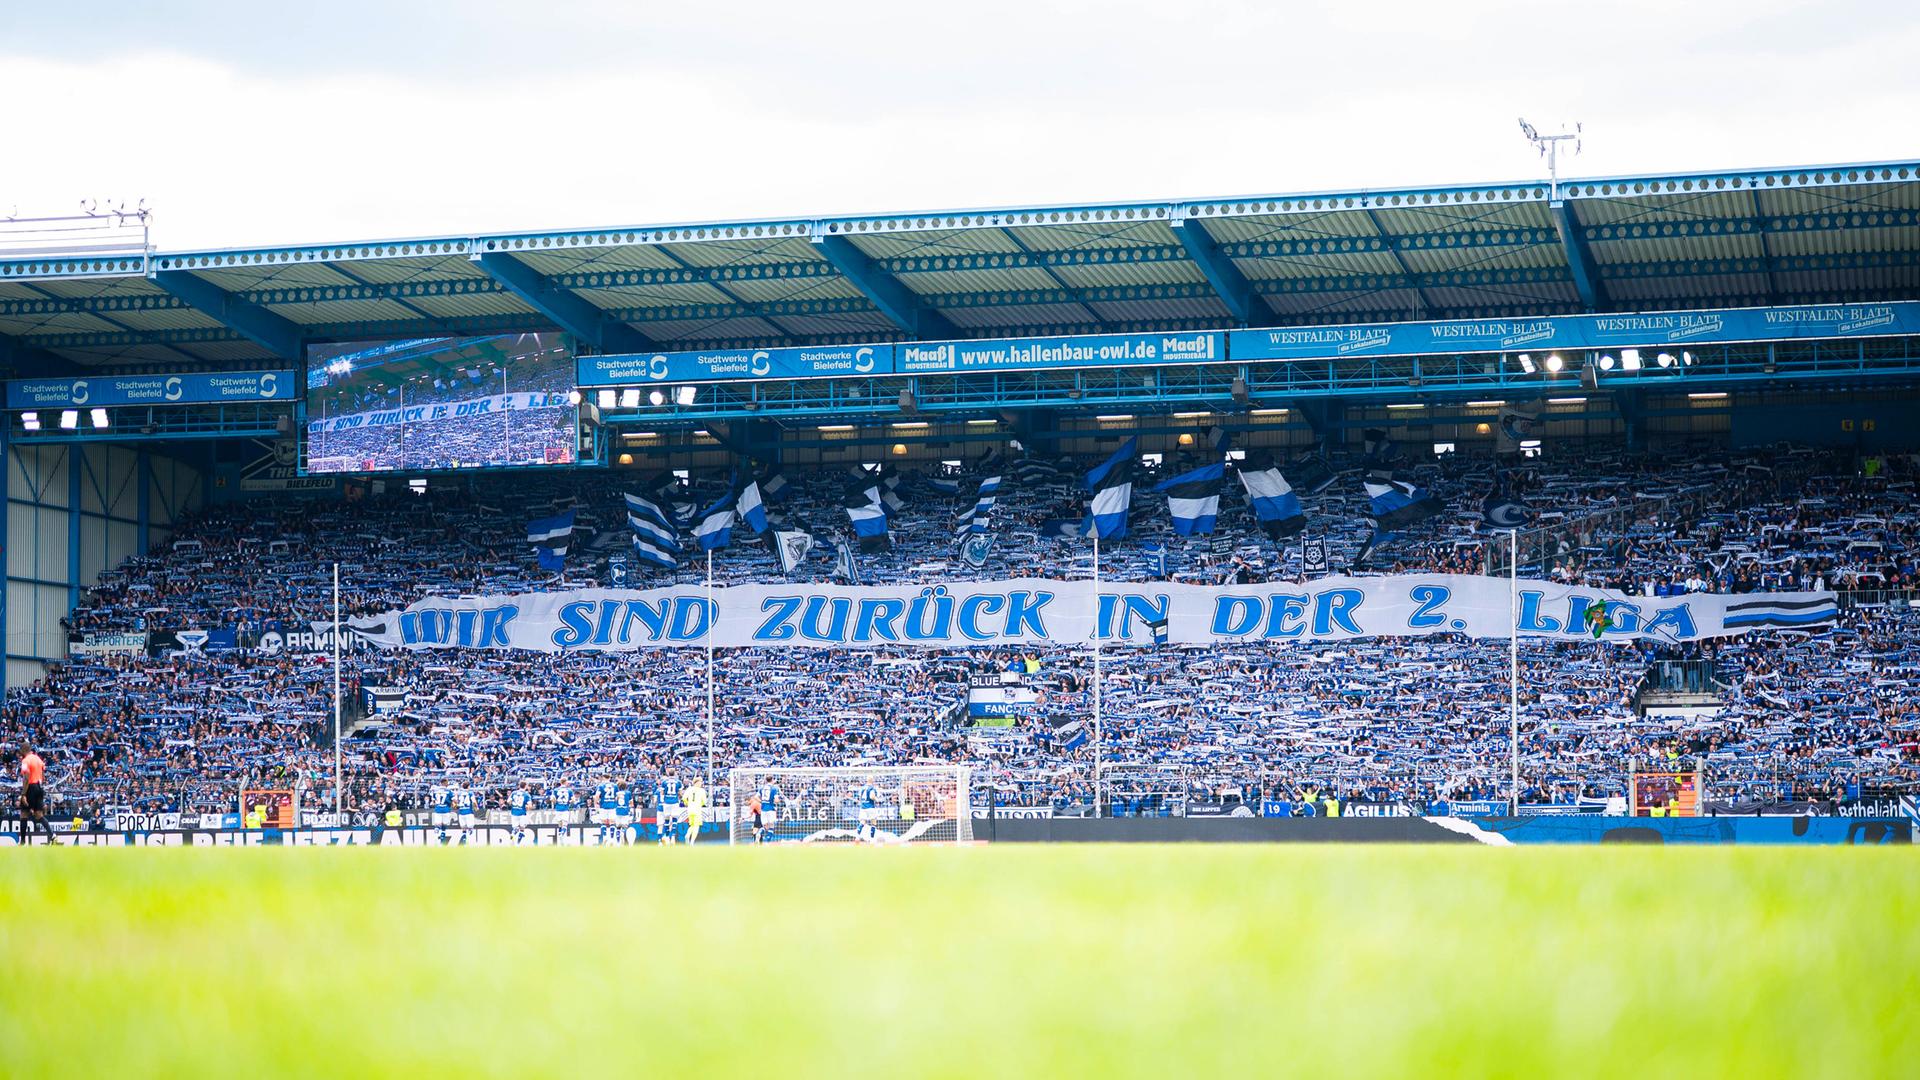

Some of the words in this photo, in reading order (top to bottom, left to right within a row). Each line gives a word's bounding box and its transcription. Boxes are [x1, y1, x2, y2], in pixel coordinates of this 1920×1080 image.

[1765, 307, 1892, 323] WESTFALEN-BLATT
[1596, 315, 1720, 331] WESTFALEN-BLATT
[1431, 322, 1552, 337] WESTFALEN-BLATT
[1269, 329, 1389, 344] WESTFALEN-BLATT
[1162, 336, 1206, 352] Maaß
[800, 351, 852, 362] Stadtwerke
[905, 346, 947, 362] Maaß
[961, 341, 1156, 365] www.hallenbau-owl.de
[596, 359, 646, 370] Stadtwerke
[697, 355, 748, 365] Stadtwerke
[813, 360, 852, 370] Bielefeld
[609, 368, 646, 378] Bielefeld
[711, 363, 748, 373] Bielefeld
[115, 381, 162, 390] Stadtwerke
[210, 377, 257, 387] Stadtwerke
[23, 384, 69, 394] Stadtwerke
[127, 389, 162, 399] Bielefeld
[222, 386, 257, 395] Bielefeld
[34, 393, 69, 402] Bielefeld
[456, 399, 492, 416] DER
[286, 480, 332, 488] BIELEFELD
[399, 604, 519, 648] WIR
[551, 596, 719, 647] SIND
[752, 584, 1055, 643] ZURÜCK
[1090, 593, 1171, 640] IN
[1209, 587, 1365, 639] DER
[1408, 584, 1469, 630] 2.
[1517, 590, 1698, 639] LIGA
[85, 635, 145, 647] SUPPORTERS
[971, 676, 1000, 686] BLUE
[666, 785, 676, 795] 11
[1268, 804, 1281, 814] 19
[1343, 802, 1411, 817] ÁGILUS
[1451, 802, 1491, 812] Arminia
[118, 814, 161, 831] PORTA
